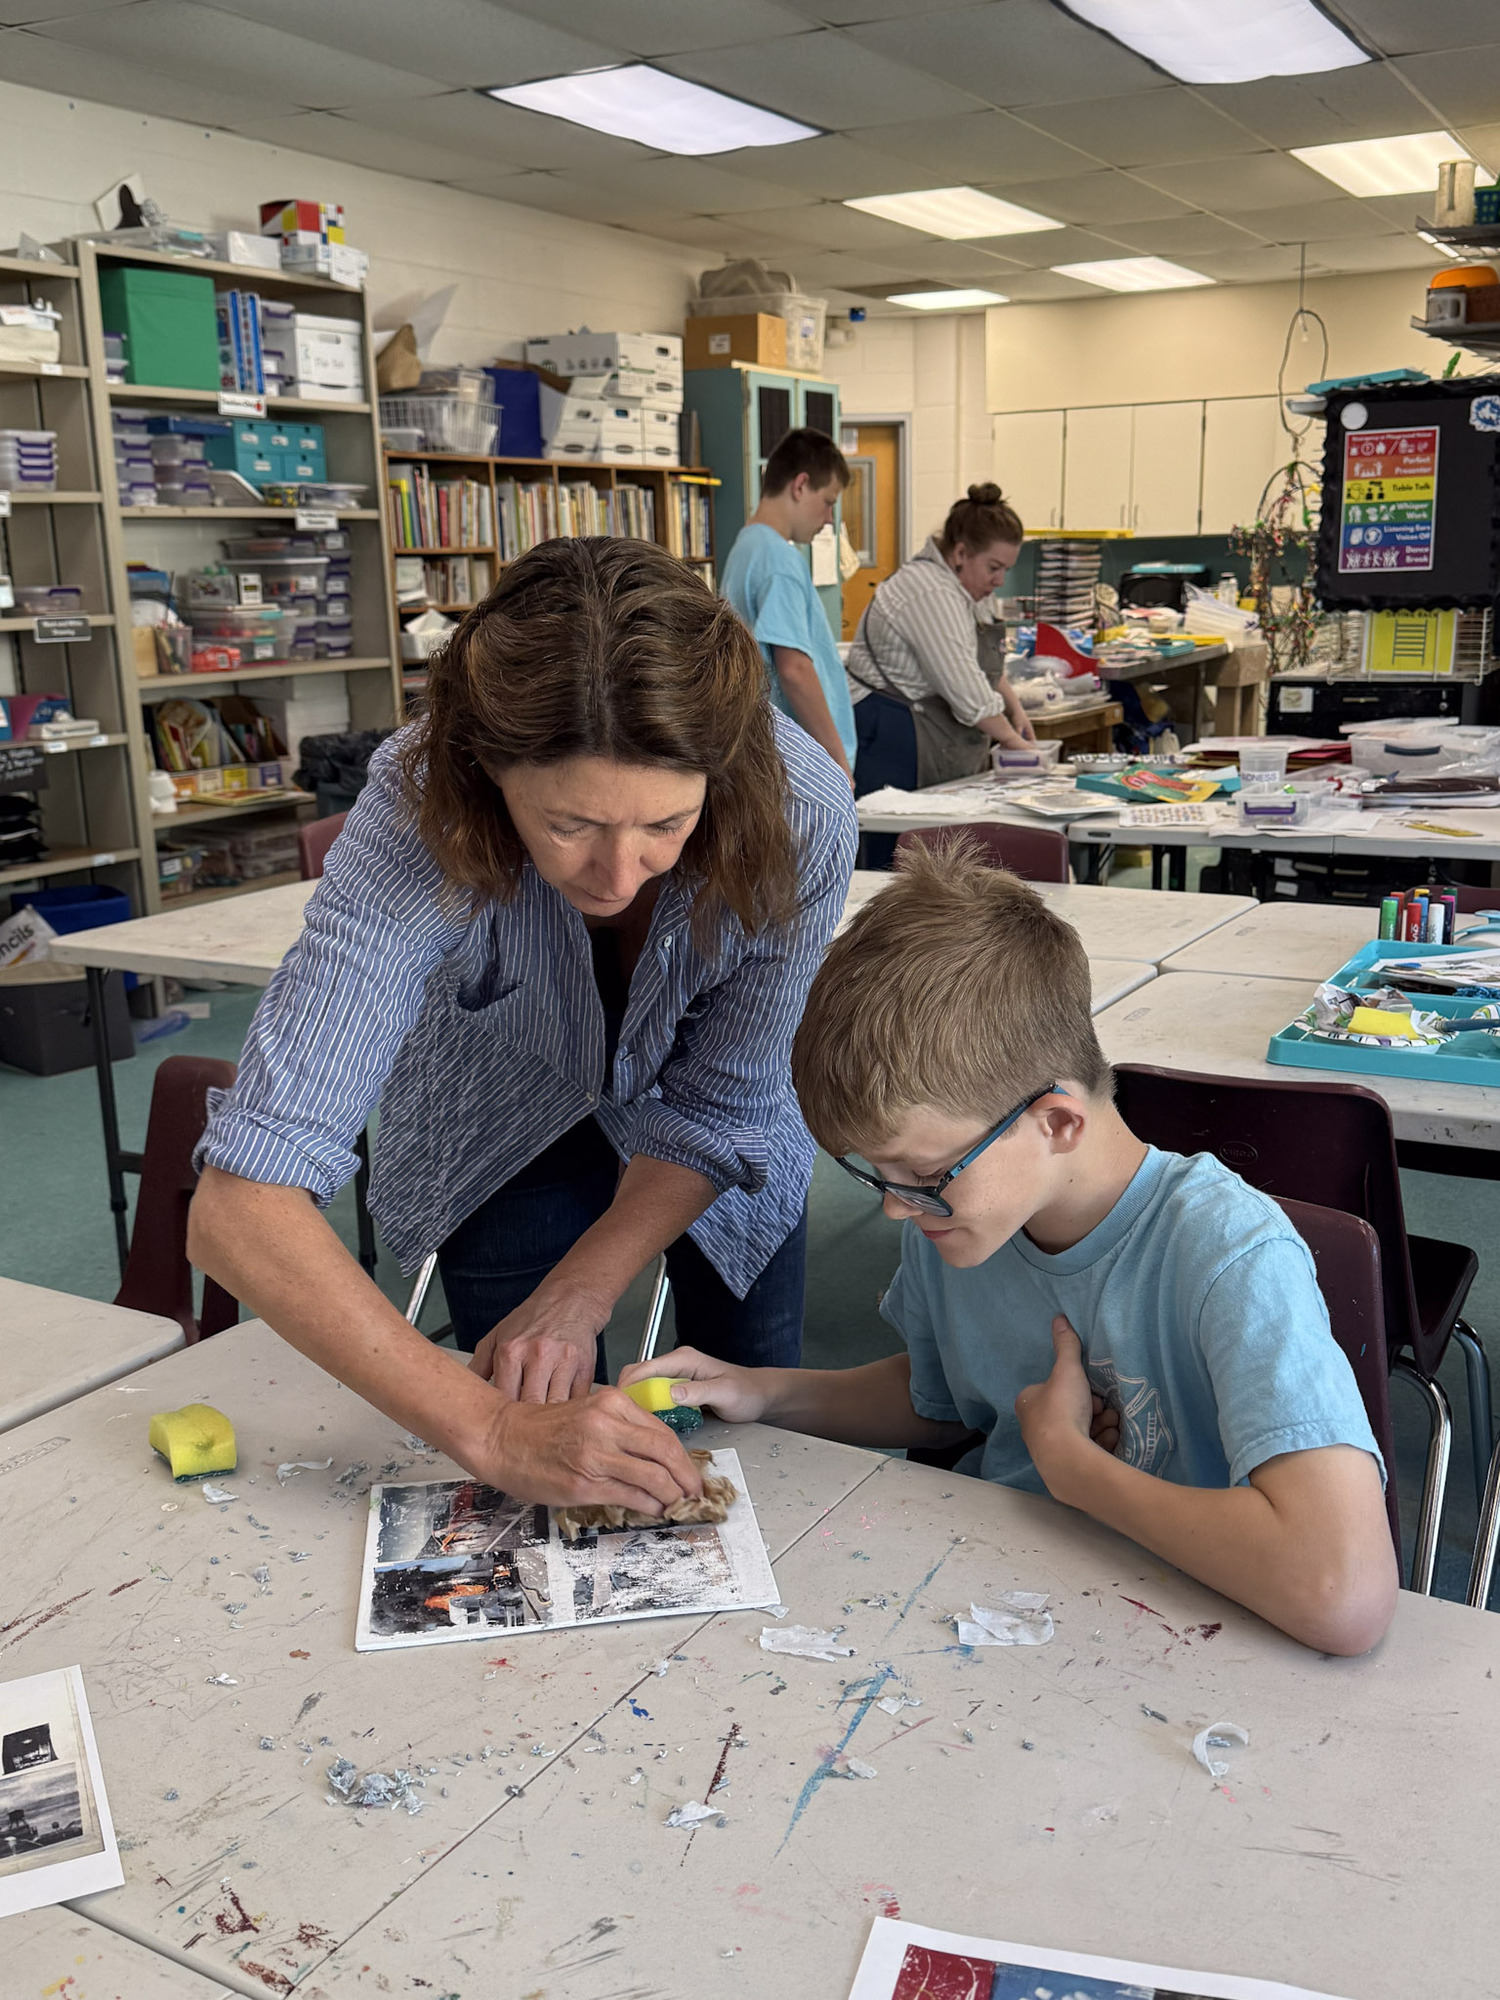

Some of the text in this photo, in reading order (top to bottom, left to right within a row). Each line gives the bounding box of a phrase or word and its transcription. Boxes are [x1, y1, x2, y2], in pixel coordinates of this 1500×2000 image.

[1403, 456, 1431, 464] Perfect
[1394, 467, 1432, 475] Presenter
[1415, 482, 1431, 490] Talk
[1406, 511, 1428, 519] Work
[1383, 525, 1415, 533] Listening
[1418, 532, 1431, 540] Off
[1405, 545, 1430, 554] Dance
[1405, 555, 1429, 564] Break
